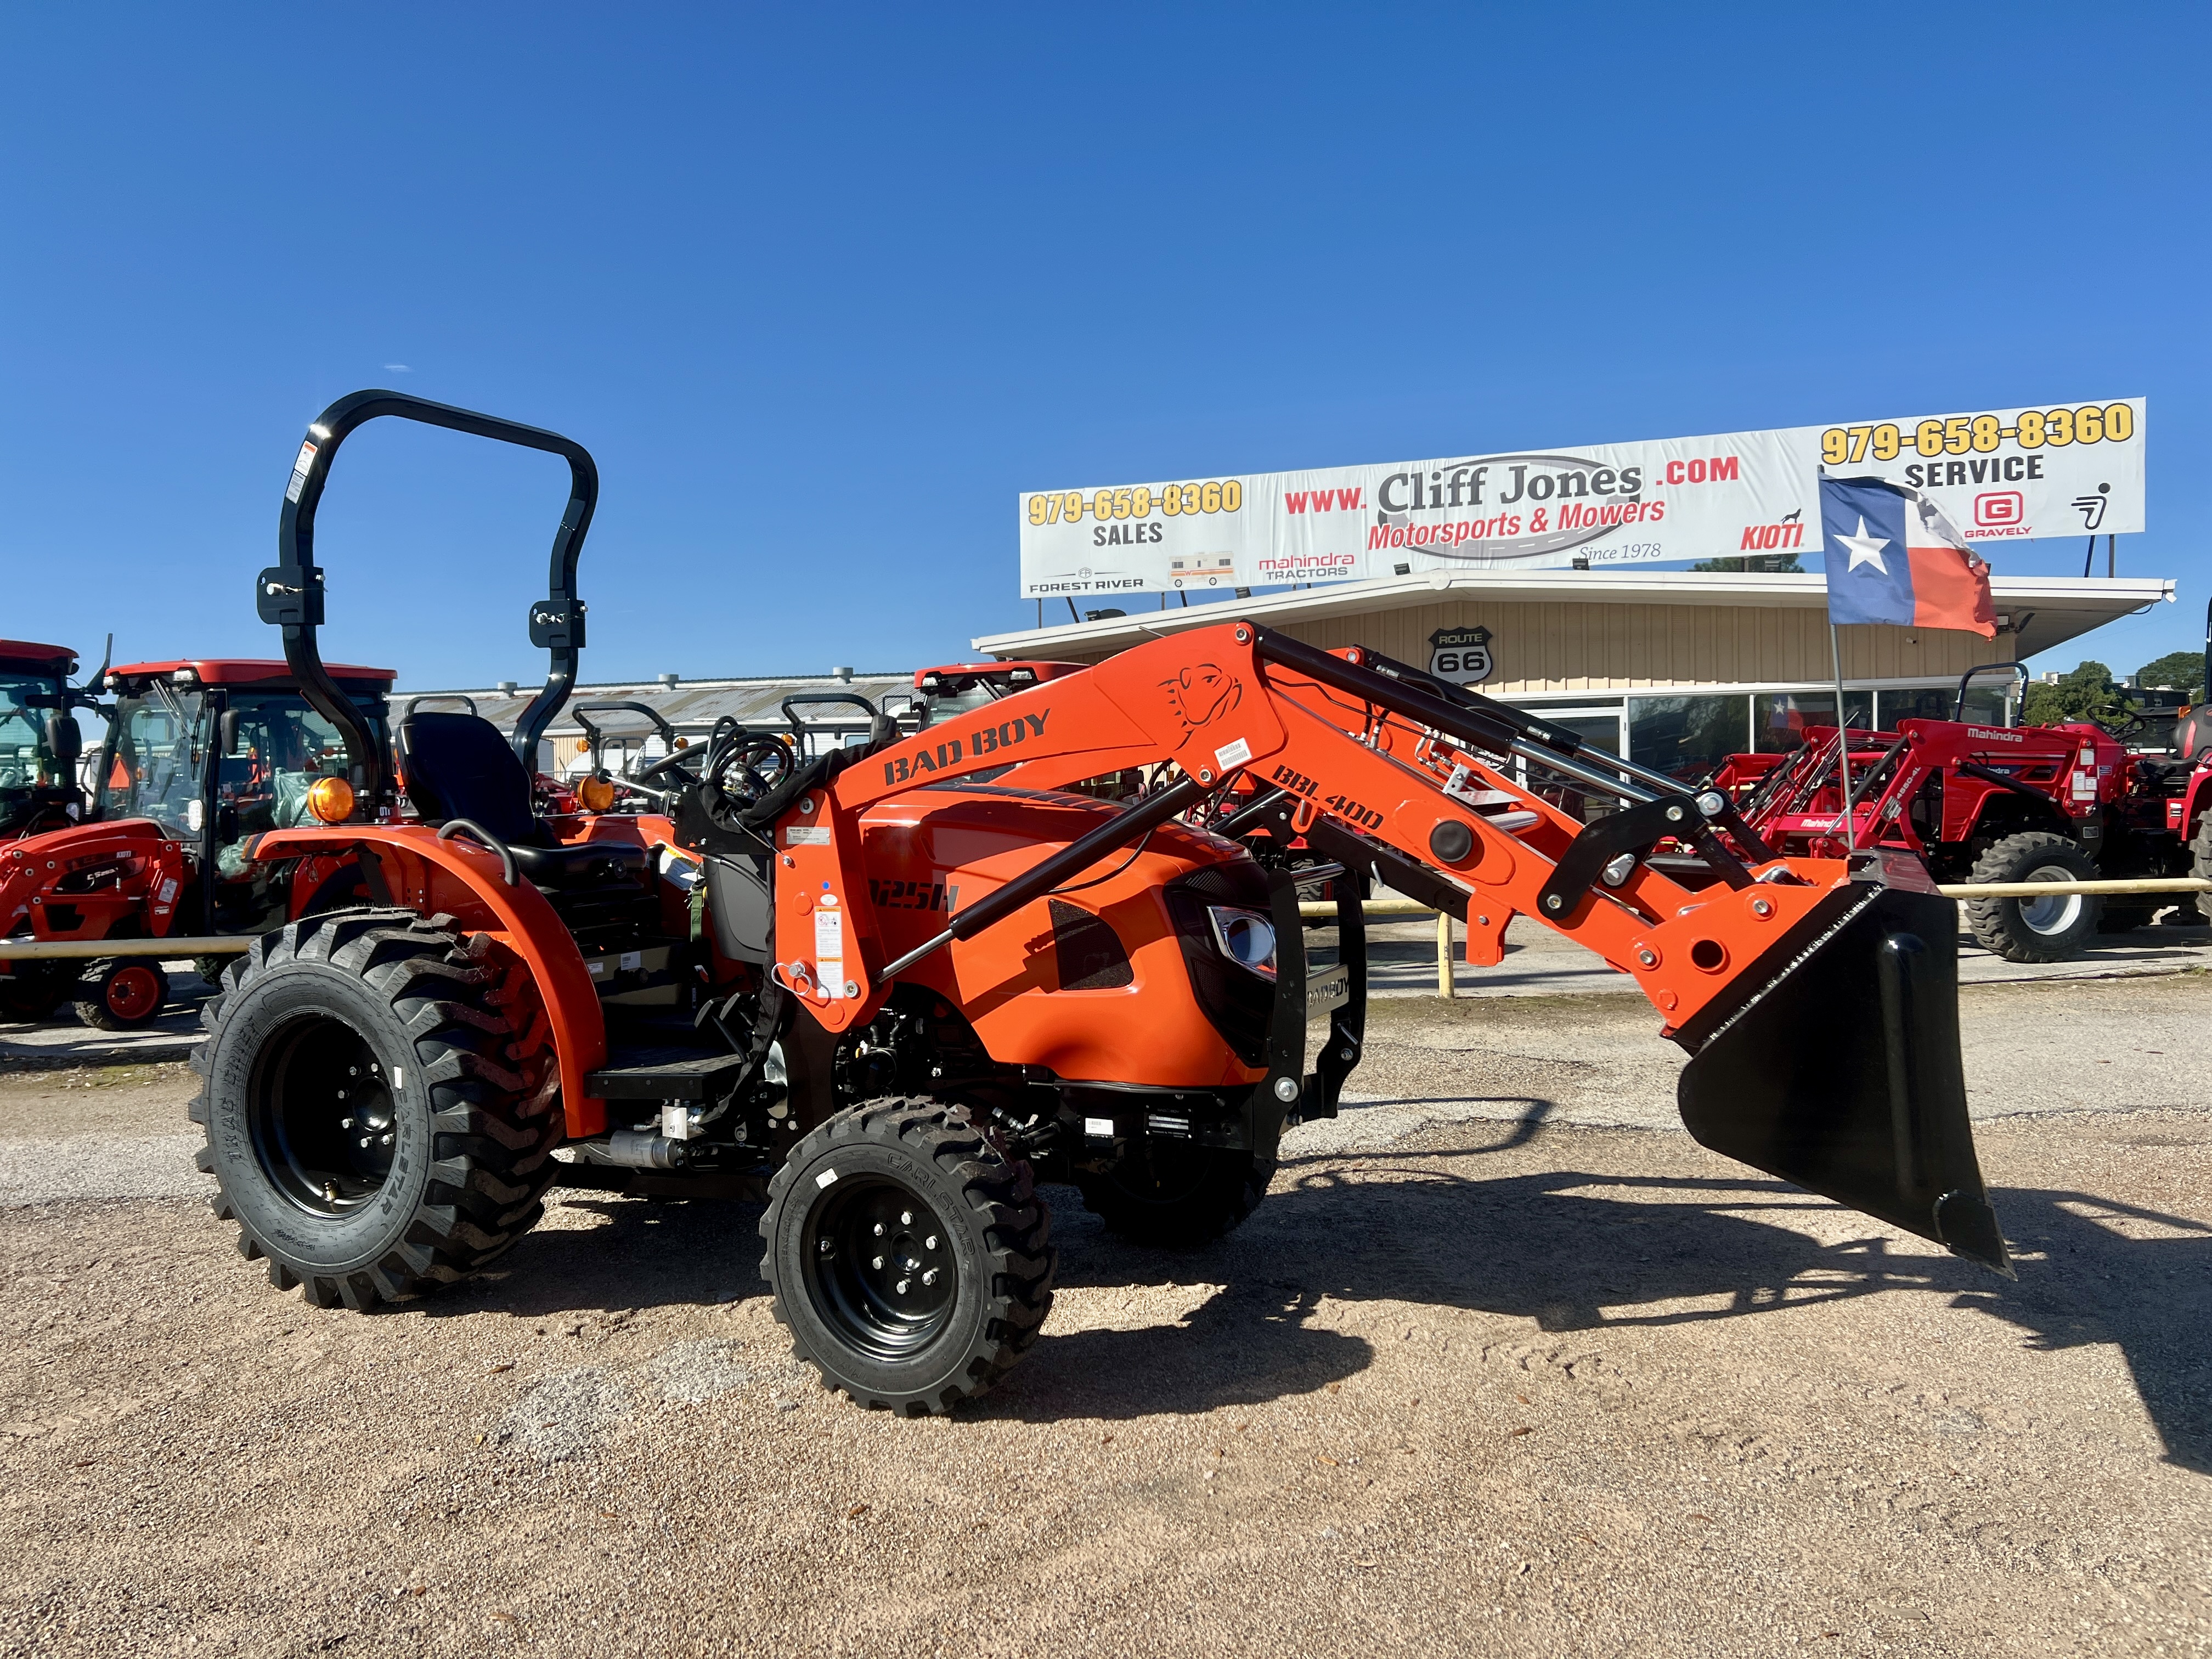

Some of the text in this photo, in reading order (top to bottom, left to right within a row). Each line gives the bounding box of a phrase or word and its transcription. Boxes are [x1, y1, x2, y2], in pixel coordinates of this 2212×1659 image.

[1821, 403, 2133, 465] 979-658-8360
[1905, 454, 2044, 488] SERVICE
[1378, 466, 1488, 514] Cliff
[1499, 463, 1642, 505] Jones
[1029, 480, 1242, 526] 979-658-8360
[1093, 522, 1163, 546] SALES
[1368, 500, 1664, 550] Motorsports & Mowers
[1741, 523, 1804, 550] KIOTI
[1965, 526, 2033, 538] GRAVELY
[1259, 552, 1355, 570] mahindra
[1578, 543, 1661, 560] Since 1978
[1030, 579, 1144, 592] FOREST RIVER
[1266, 566, 1348, 580] TRACTORS
[1439, 633, 1482, 645] ROUTE
[1437, 651, 1485, 673] 66
[884, 707, 1051, 787] BAD BOY
[1967, 727, 2023, 742] Mahindra
[1271, 764, 1384, 831] BBL 400
[1801, 819, 1842, 828] Mahinda
[381, 1088, 411, 1216] CARLSTAR
[887, 1153, 975, 1256] CARLSTAR
